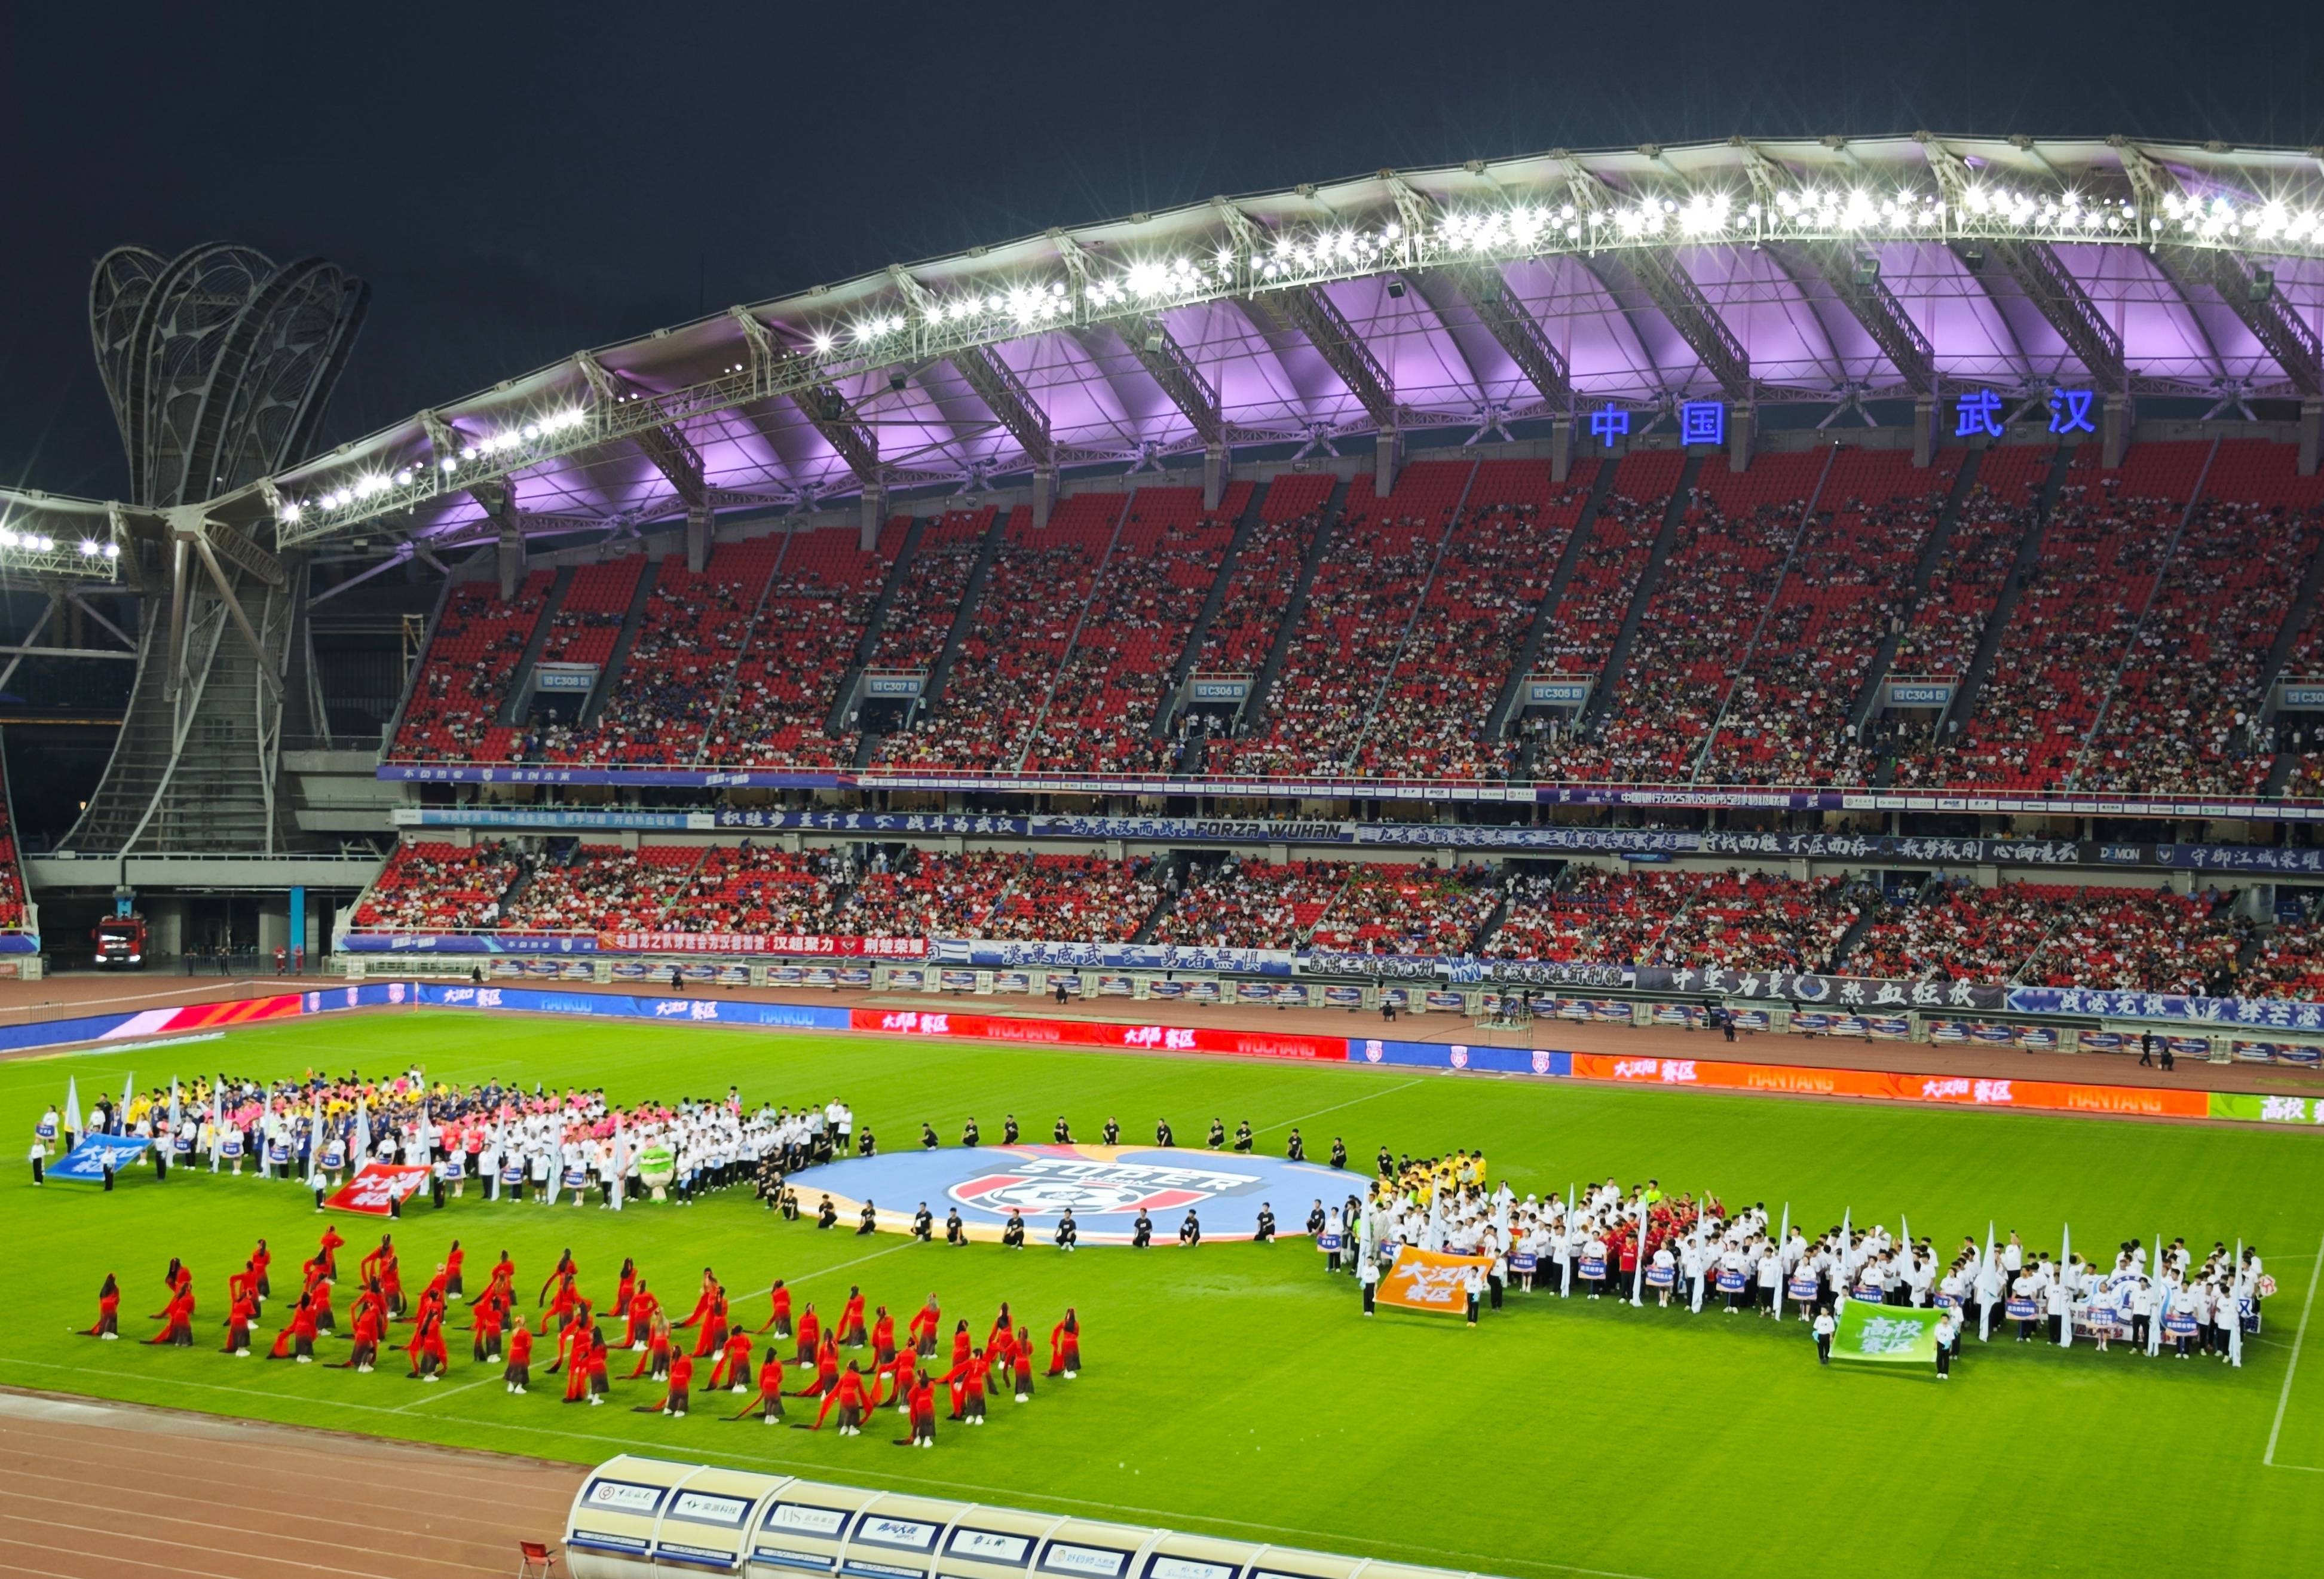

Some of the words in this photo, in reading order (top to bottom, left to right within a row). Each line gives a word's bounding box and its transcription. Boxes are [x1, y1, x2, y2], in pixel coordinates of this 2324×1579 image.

[1591, 402, 1723, 447] 中国
[1955, 389, 2096, 437] 武汉
[1208, 686, 1232, 696] C306
[1545, 688, 1570, 698] C305
[1905, 690, 1934, 700] C304
[906, 814, 1016, 835] 战斗为武汉
[1194, 821, 1260, 838] FORZA
[1267, 823, 1342, 840] WUHAN
[2101, 847, 2141, 860] DEMON
[773, 936, 834, 952] 汉超聚力
[864, 937, 924, 954] 荆楚荣耀
[1671, 968, 1786, 999] 中坚力量
[444, 988, 474, 1004] 大汉口
[477, 988, 503, 1007] 赛区
[656, 1001, 688, 1016] 大汉口
[691, 1000, 718, 1019] 赛区
[921, 1014, 949, 1034] 赛区
[1165, 1029, 1196, 1050] 赛区
[1613, 1060, 1657, 1078] 大汉阳
[1661, 1060, 1697, 1083] 赛区
[1922, 1080, 1969, 1099] 大汉阳
[1974, 1080, 2013, 1103] 赛区
[2261, 1096, 2306, 1121] 高校
[1009, 1163, 1243, 1191] SUPER
[1406, 1284, 1456, 1302] 赛区
[1862, 1316, 1923, 1338] 高校
[1860, 1338, 1915, 1354] 赛区
